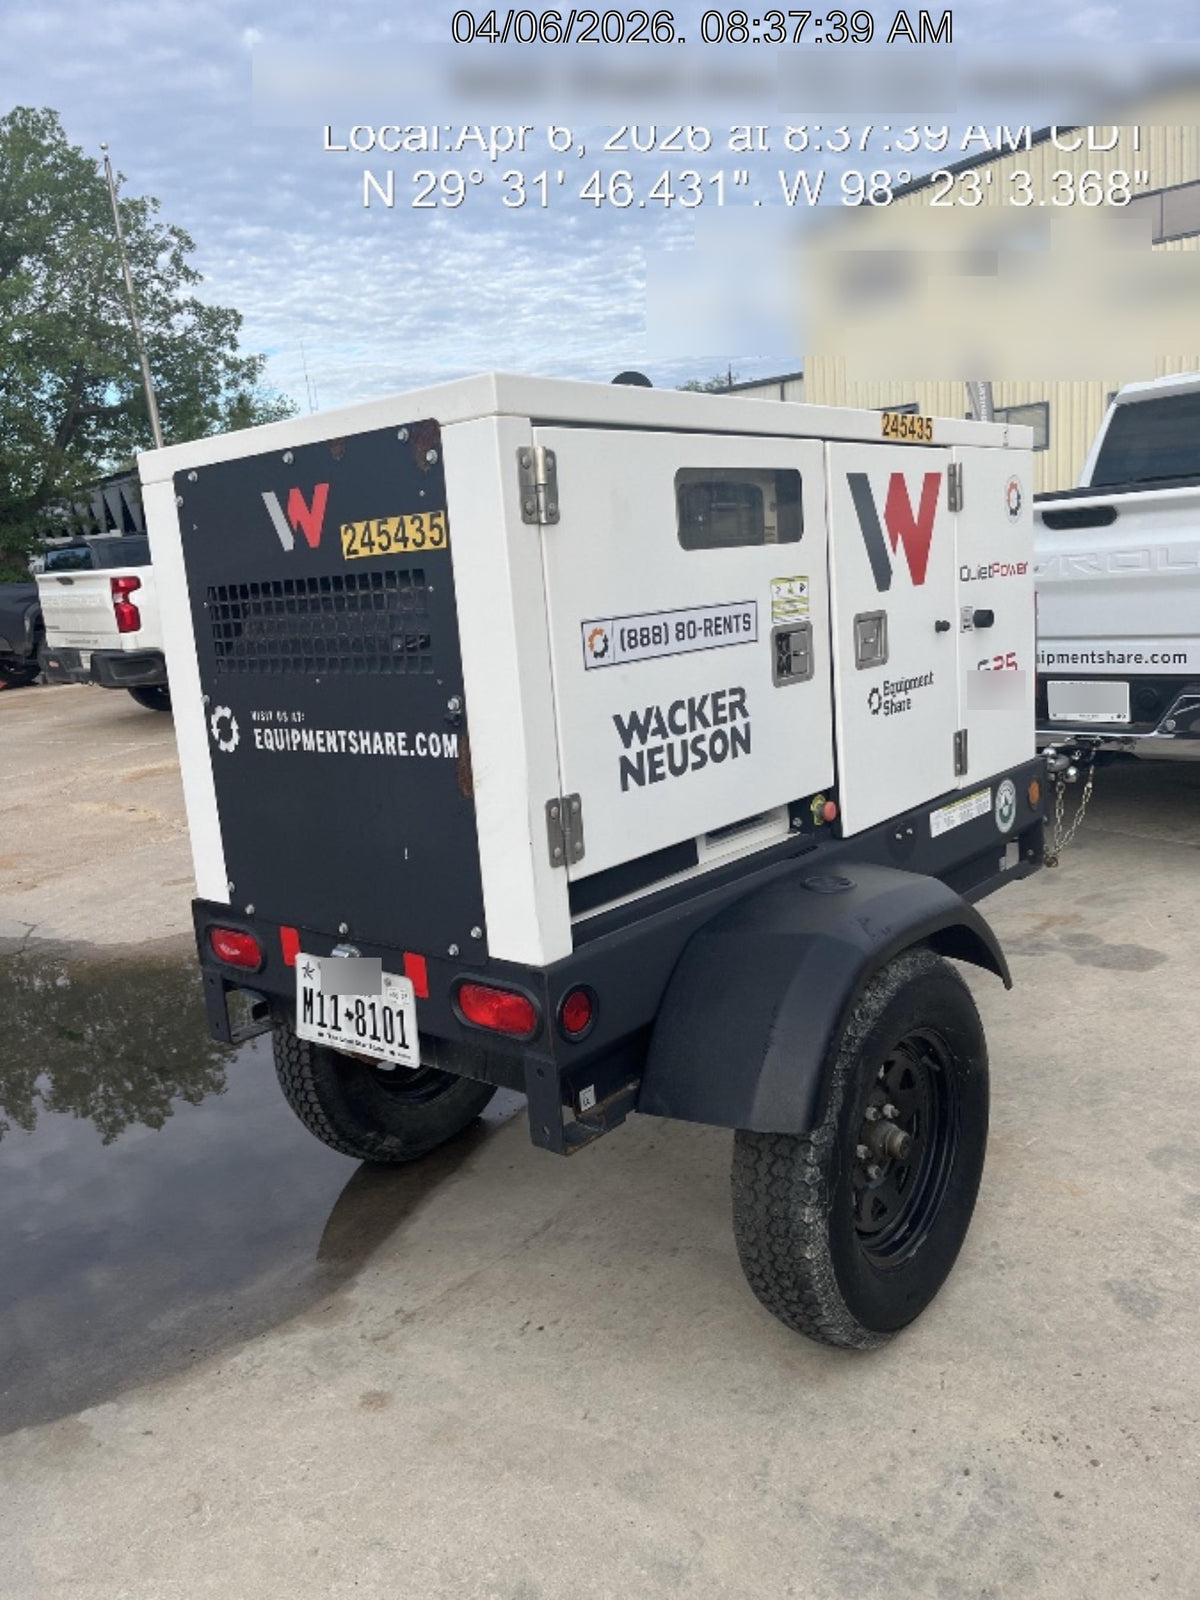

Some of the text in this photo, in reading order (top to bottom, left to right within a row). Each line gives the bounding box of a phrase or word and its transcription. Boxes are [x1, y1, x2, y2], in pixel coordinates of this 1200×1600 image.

[882, 413, 932, 441] 245435
[343, 512, 444, 557] 245435
[960, 562, 1028, 581] QuietPower
[620, 613, 751, 652] (888) 80-RENTS
[883, 671, 934, 697] Equipment
[612, 686, 749, 749] WACKER
[883, 698, 911, 716] Share
[254, 728, 459, 758] EQUIPMENTSHARE.COM
[618, 722, 751, 791] NEUSON
